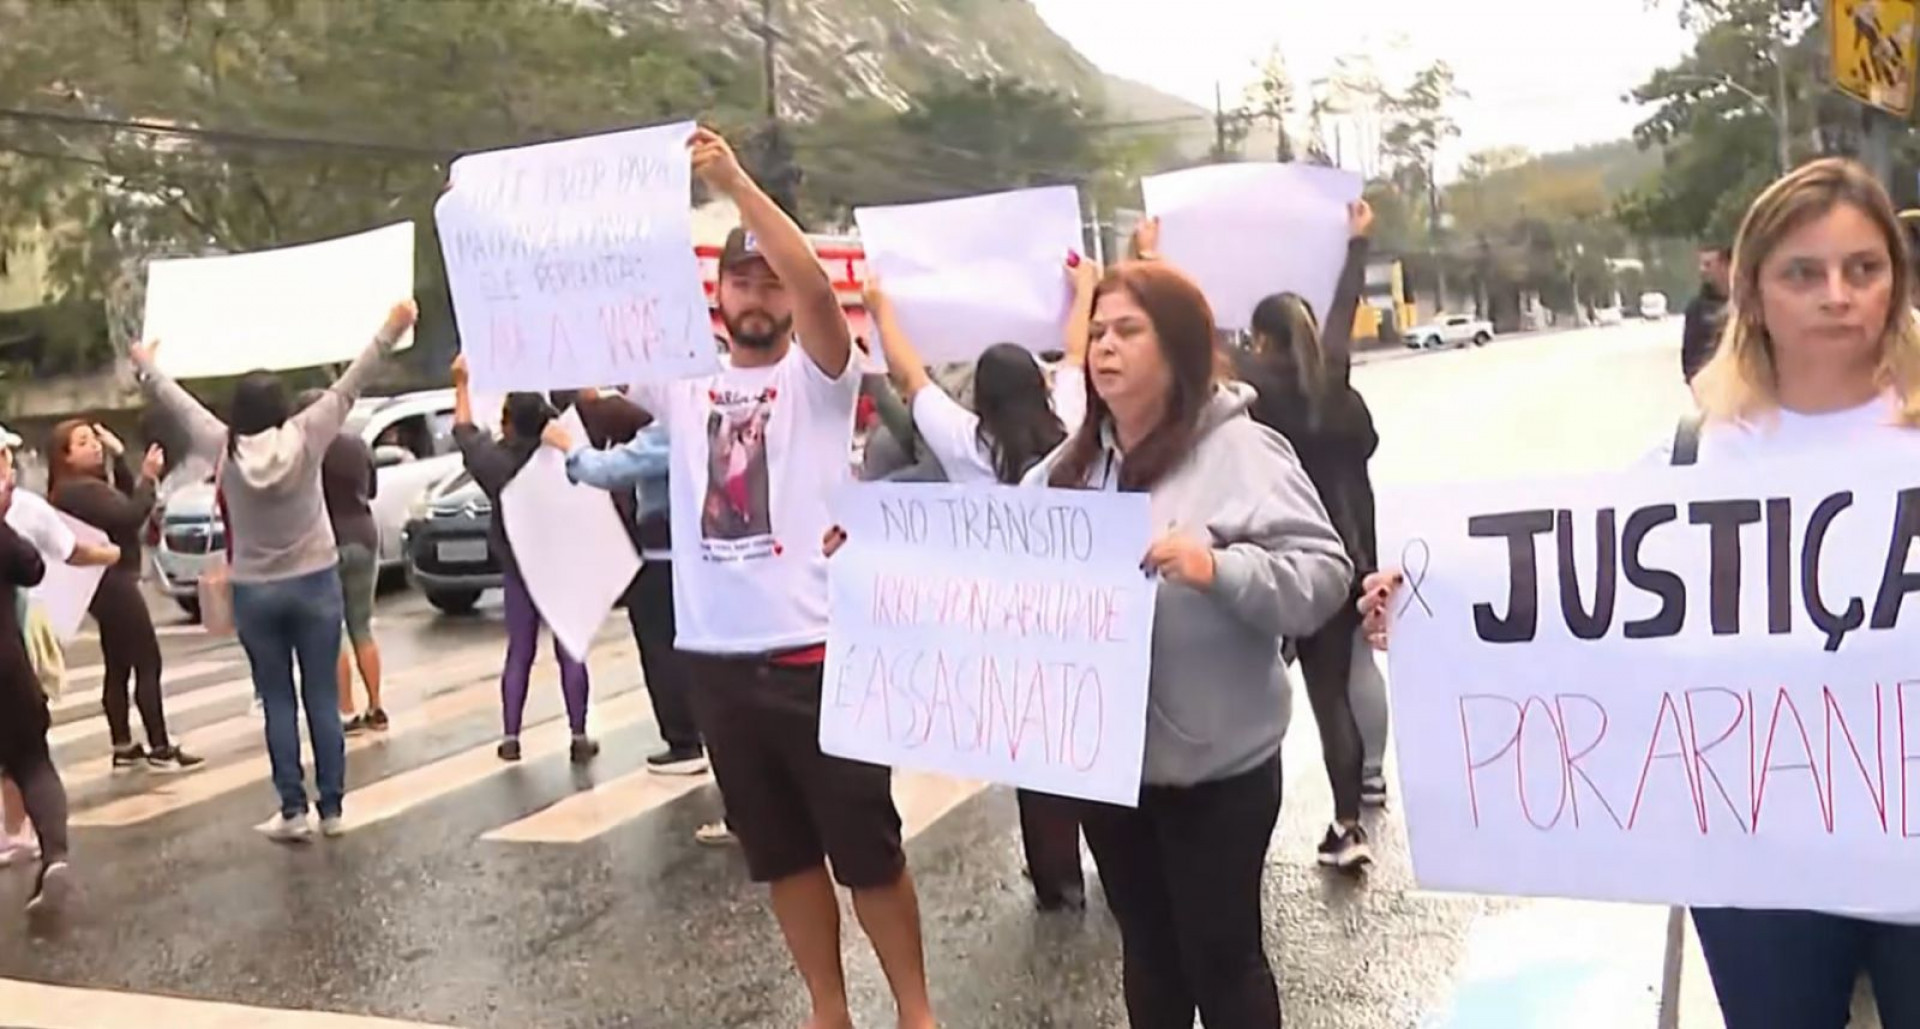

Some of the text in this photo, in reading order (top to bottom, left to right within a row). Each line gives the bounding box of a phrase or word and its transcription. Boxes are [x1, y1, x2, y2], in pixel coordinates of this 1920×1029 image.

[880, 496, 1092, 562] NO TRÂNSITO
[1468, 487, 1920, 651] JUSTIÇA
[1459, 693, 1623, 830] POR
